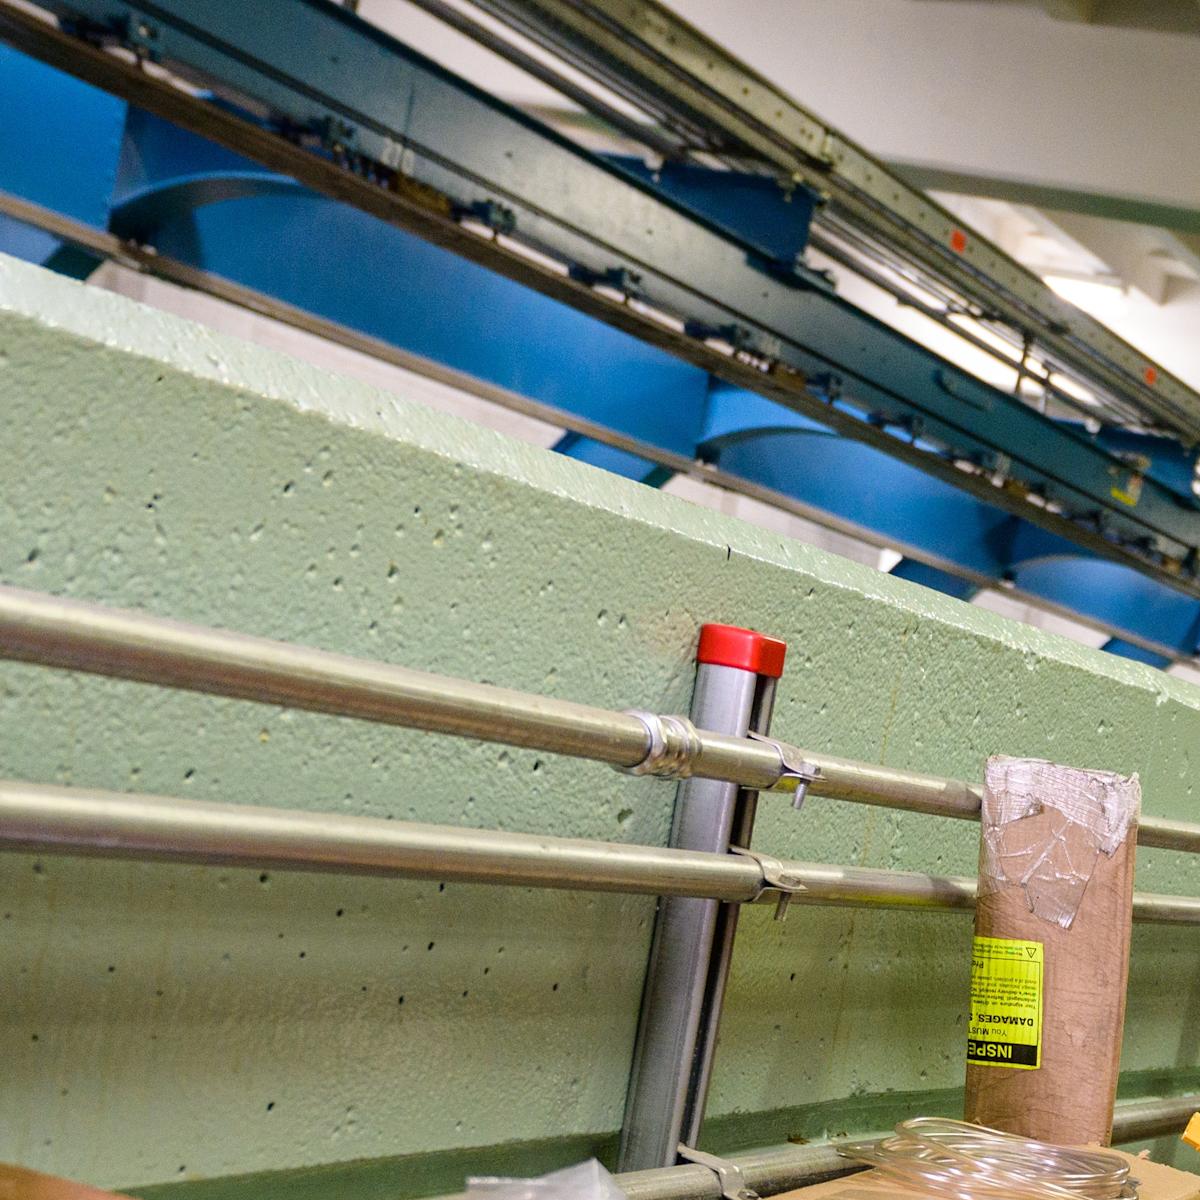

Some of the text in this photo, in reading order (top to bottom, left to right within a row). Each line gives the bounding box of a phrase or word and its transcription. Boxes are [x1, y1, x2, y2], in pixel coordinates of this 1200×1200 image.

[976, 1012, 1034, 1027] DAMAGES,
[991, 1028, 1007, 1037] You
[968, 1042, 1013, 1059] INSPE
